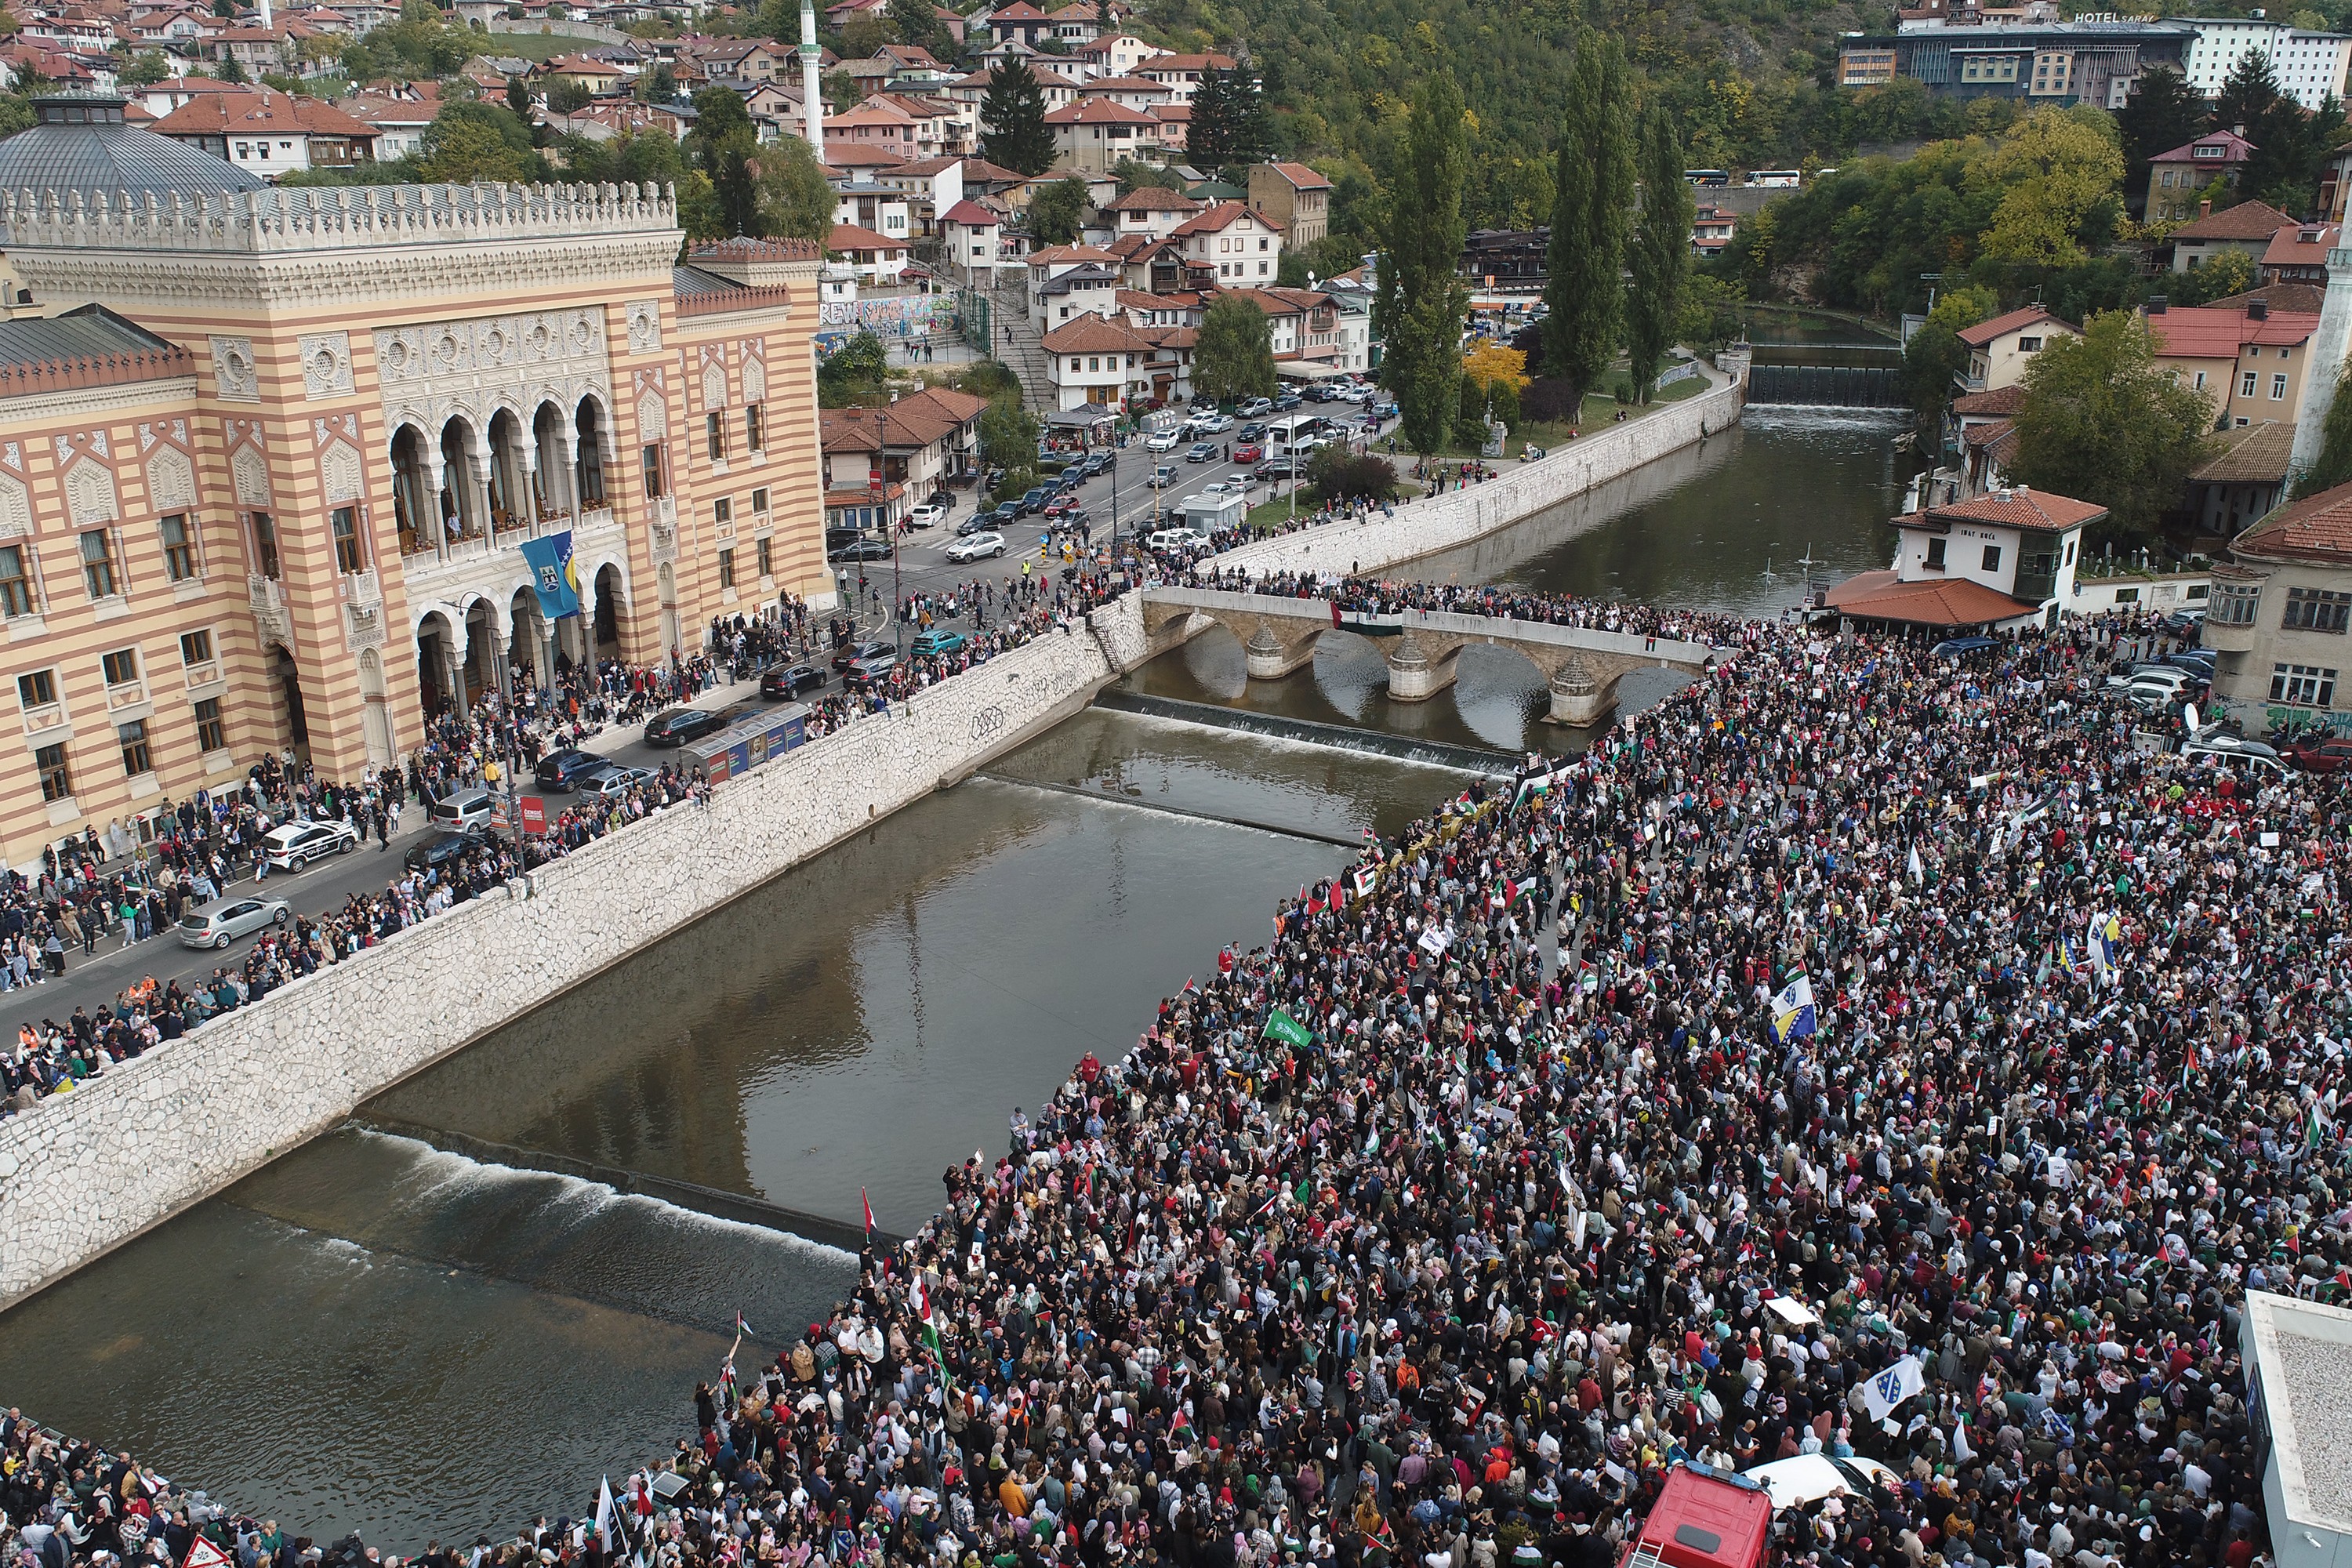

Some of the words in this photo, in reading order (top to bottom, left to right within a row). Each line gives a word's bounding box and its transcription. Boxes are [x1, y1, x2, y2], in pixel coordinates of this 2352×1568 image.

[2074, 13, 2119, 23] HOTEL
[1960, 529, 1976, 538] INAT
[307, 844, 329, 856] POLICIJA
